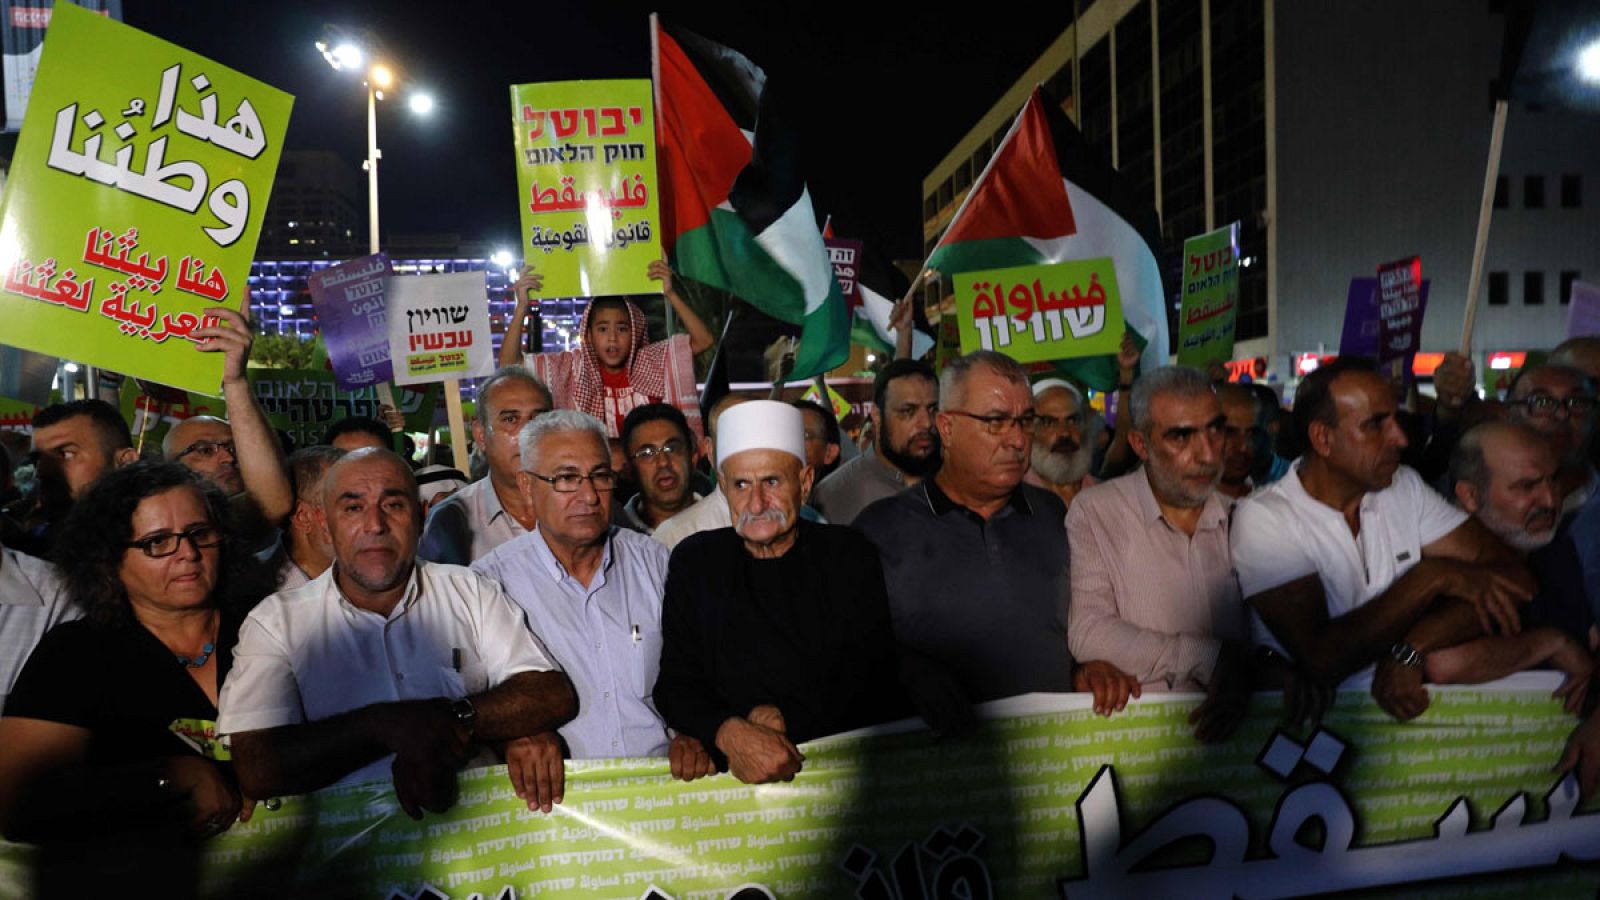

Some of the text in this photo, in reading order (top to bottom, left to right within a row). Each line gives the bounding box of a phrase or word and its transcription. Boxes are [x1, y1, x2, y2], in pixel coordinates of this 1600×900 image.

[151, 63, 267, 160] هذا
[522, 105, 643, 142] יבוטל
[603, 143, 644, 164] חוק
[1189, 247, 1233, 276] בוטל
[175, 255, 229, 302] هنا
[352, 296, 385, 316] انون
[406, 305, 469, 333] שוויון
[409, 330, 472, 352] עכשיו
[975, 303, 1105, 352] שוויון
[678, 785, 751, 805] מוקרטיה
[477, 828, 558, 855] דמוקרטיה
[696, 836, 742, 855] שוויון
[447, 866, 495, 889] שוויון
